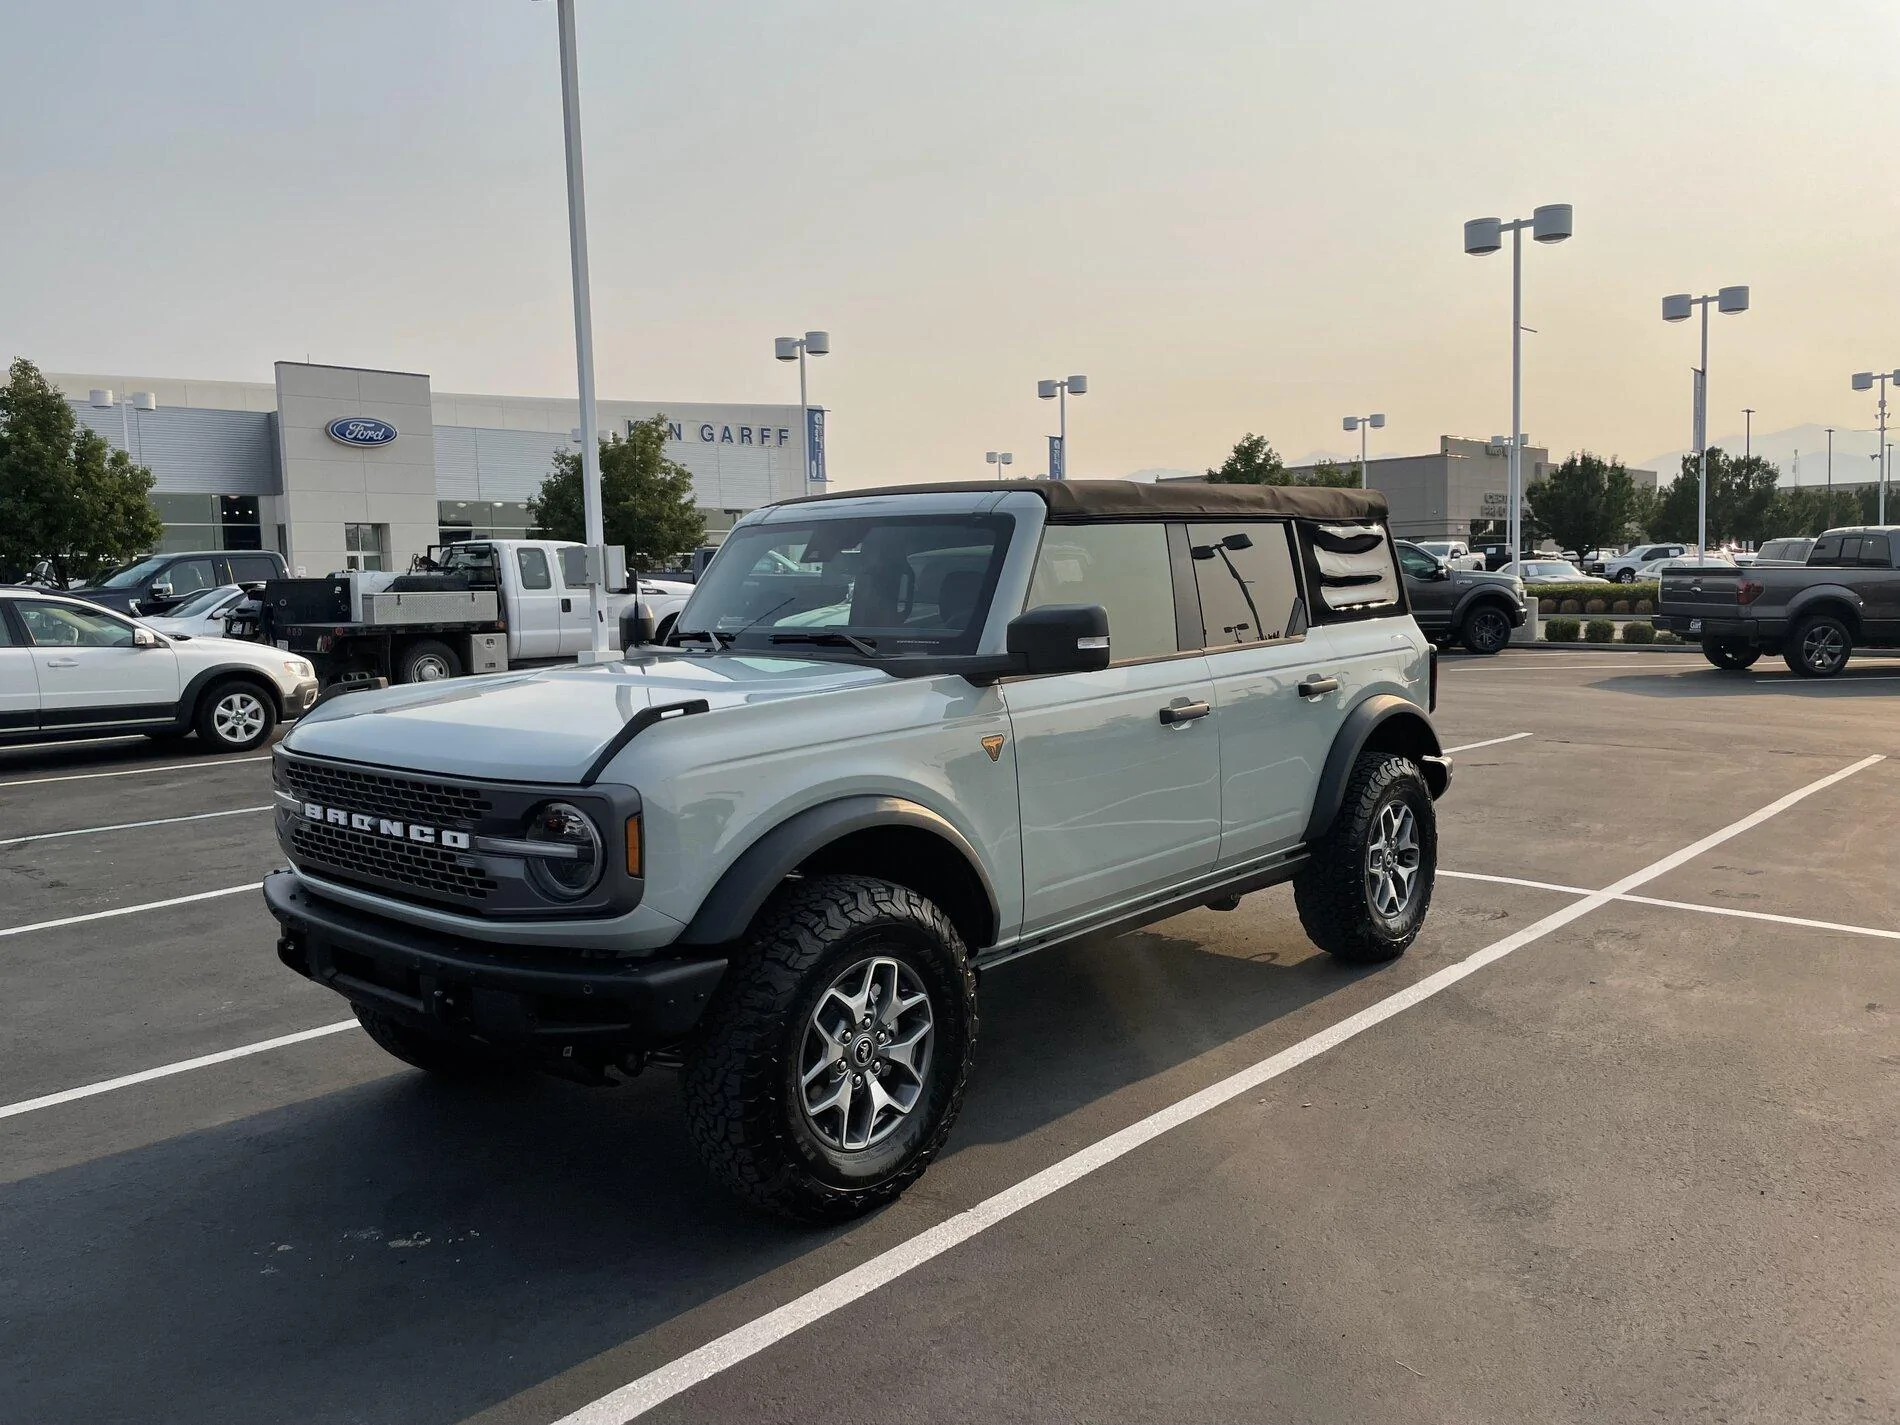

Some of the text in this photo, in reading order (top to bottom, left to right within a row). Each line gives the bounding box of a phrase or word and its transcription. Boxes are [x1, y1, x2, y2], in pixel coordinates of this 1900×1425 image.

[345, 422, 384, 440] Ford
[700, 424, 789, 446] GARFF
[304, 803, 470, 849] BRONCO
